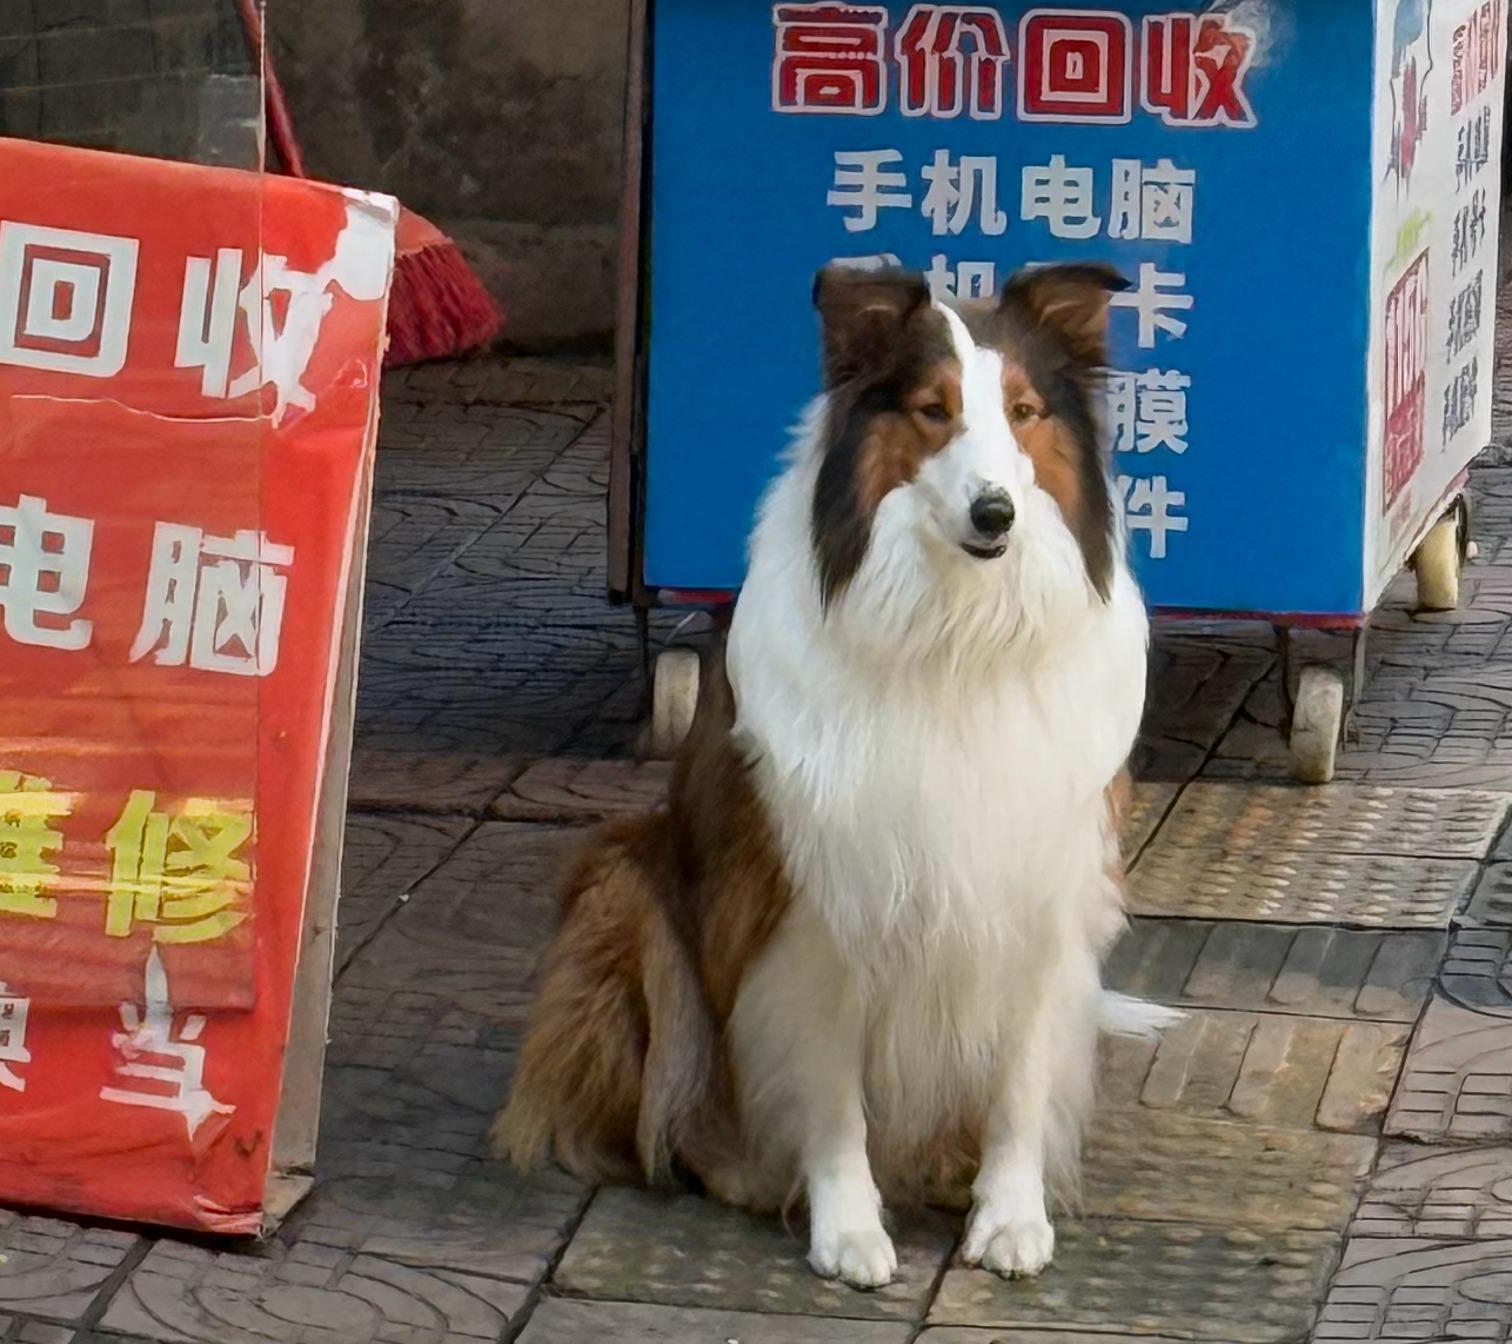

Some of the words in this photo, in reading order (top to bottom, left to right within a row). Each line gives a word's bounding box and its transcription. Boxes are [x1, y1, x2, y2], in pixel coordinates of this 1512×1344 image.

[771, 0, 1258, 129] 高价回收
[826, 148, 1197, 245] 手机电脑
